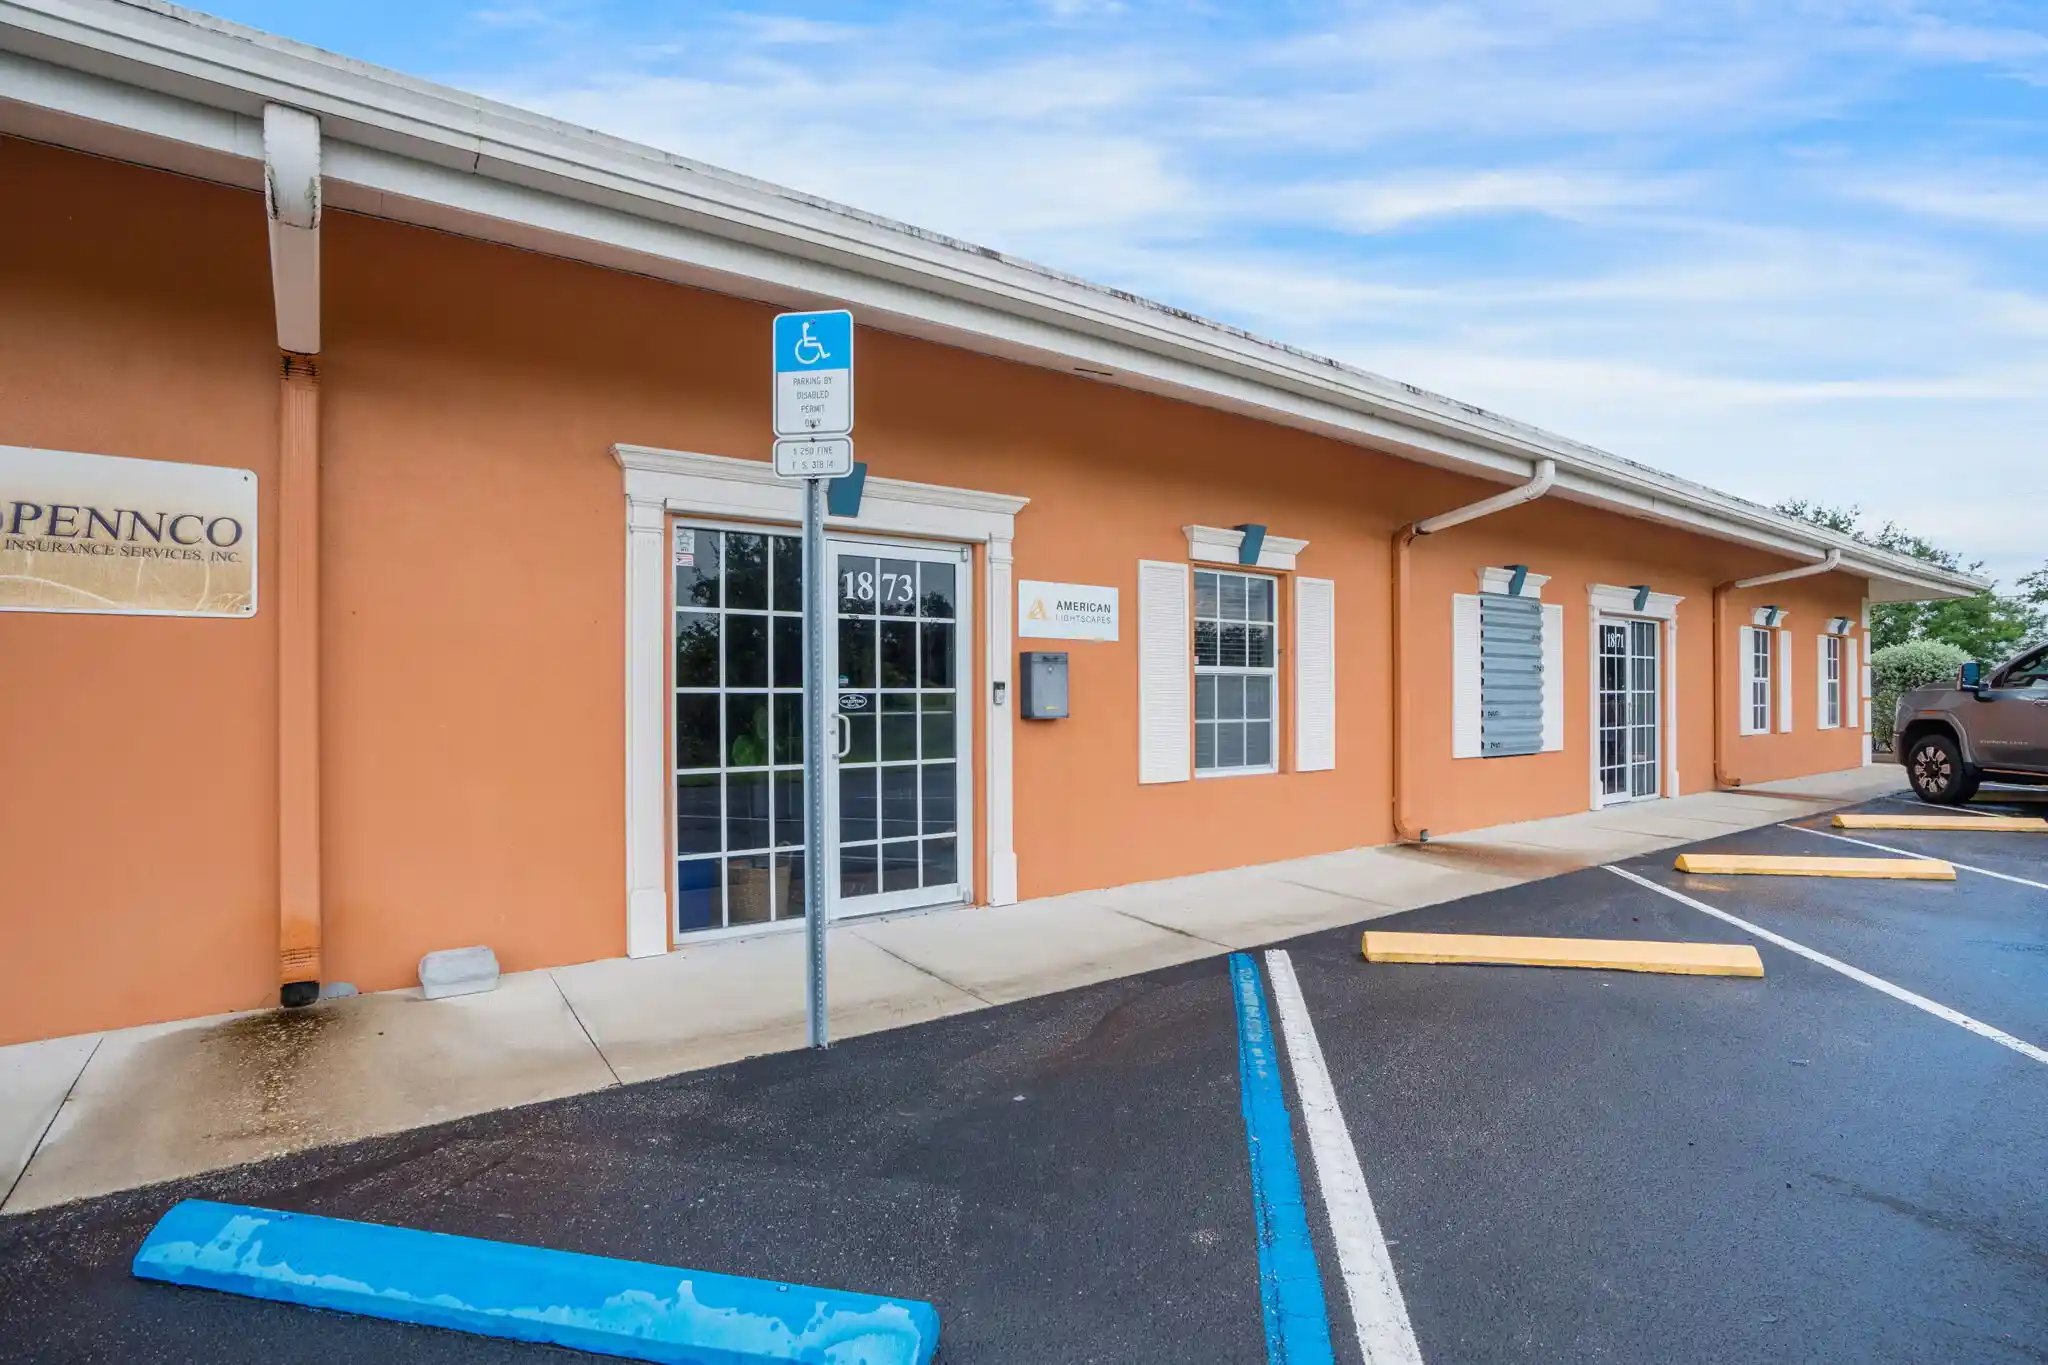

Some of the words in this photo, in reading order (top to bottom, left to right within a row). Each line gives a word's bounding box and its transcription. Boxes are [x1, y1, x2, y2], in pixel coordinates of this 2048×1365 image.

[792, 377, 821, 386] PARKING
[823, 376, 833, 385] BY
[796, 390, 830, 400] DISABLED
[800, 404, 825, 414] PERMIT
[817, 446, 833, 455] FINE
[5, 539, 115, 556] INSURANCE
[843, 571, 914, 602] 1873
[1056, 600, 1111, 613] AMERICAN
[1055, 614, 1111, 625] LIGHTSCAPES
[1607, 633, 1624, 648] 1871
